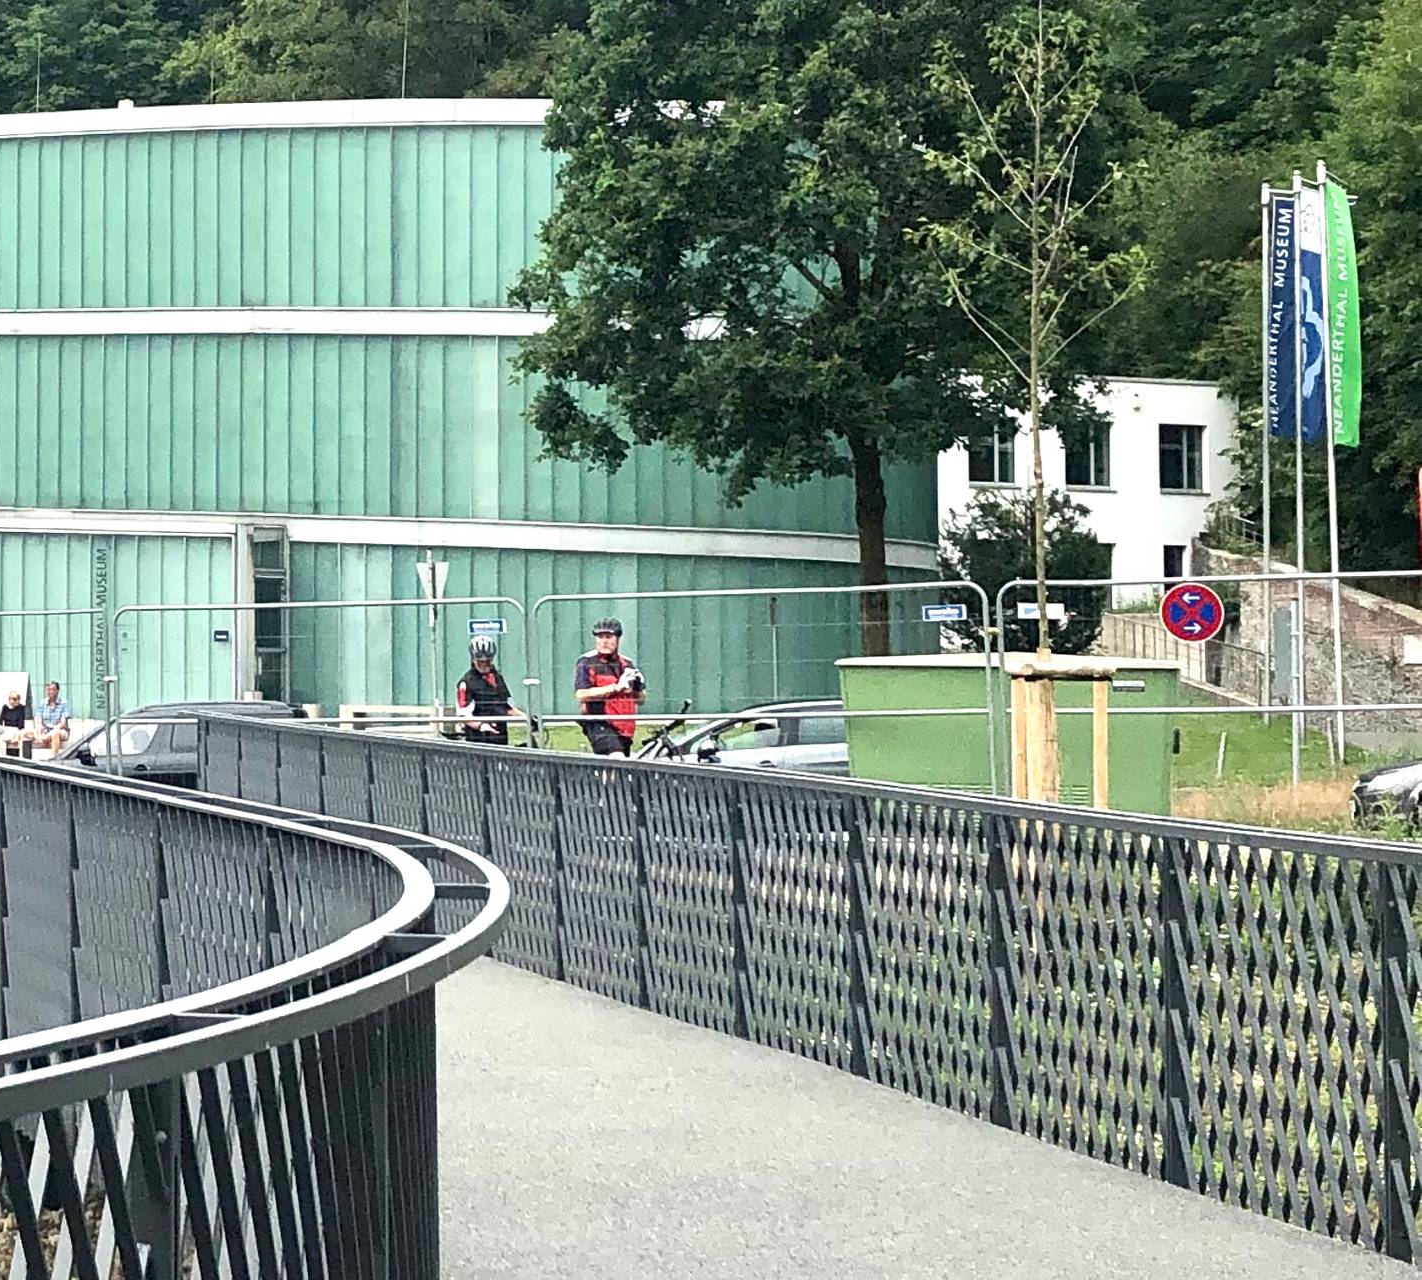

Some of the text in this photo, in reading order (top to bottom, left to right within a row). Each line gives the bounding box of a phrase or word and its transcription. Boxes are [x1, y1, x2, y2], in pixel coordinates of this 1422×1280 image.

[1274, 207, 1294, 288] MUSEUM
[1332, 288, 1349, 434] NEANDERTHAL
[95, 548, 108, 607] MUSEUM
